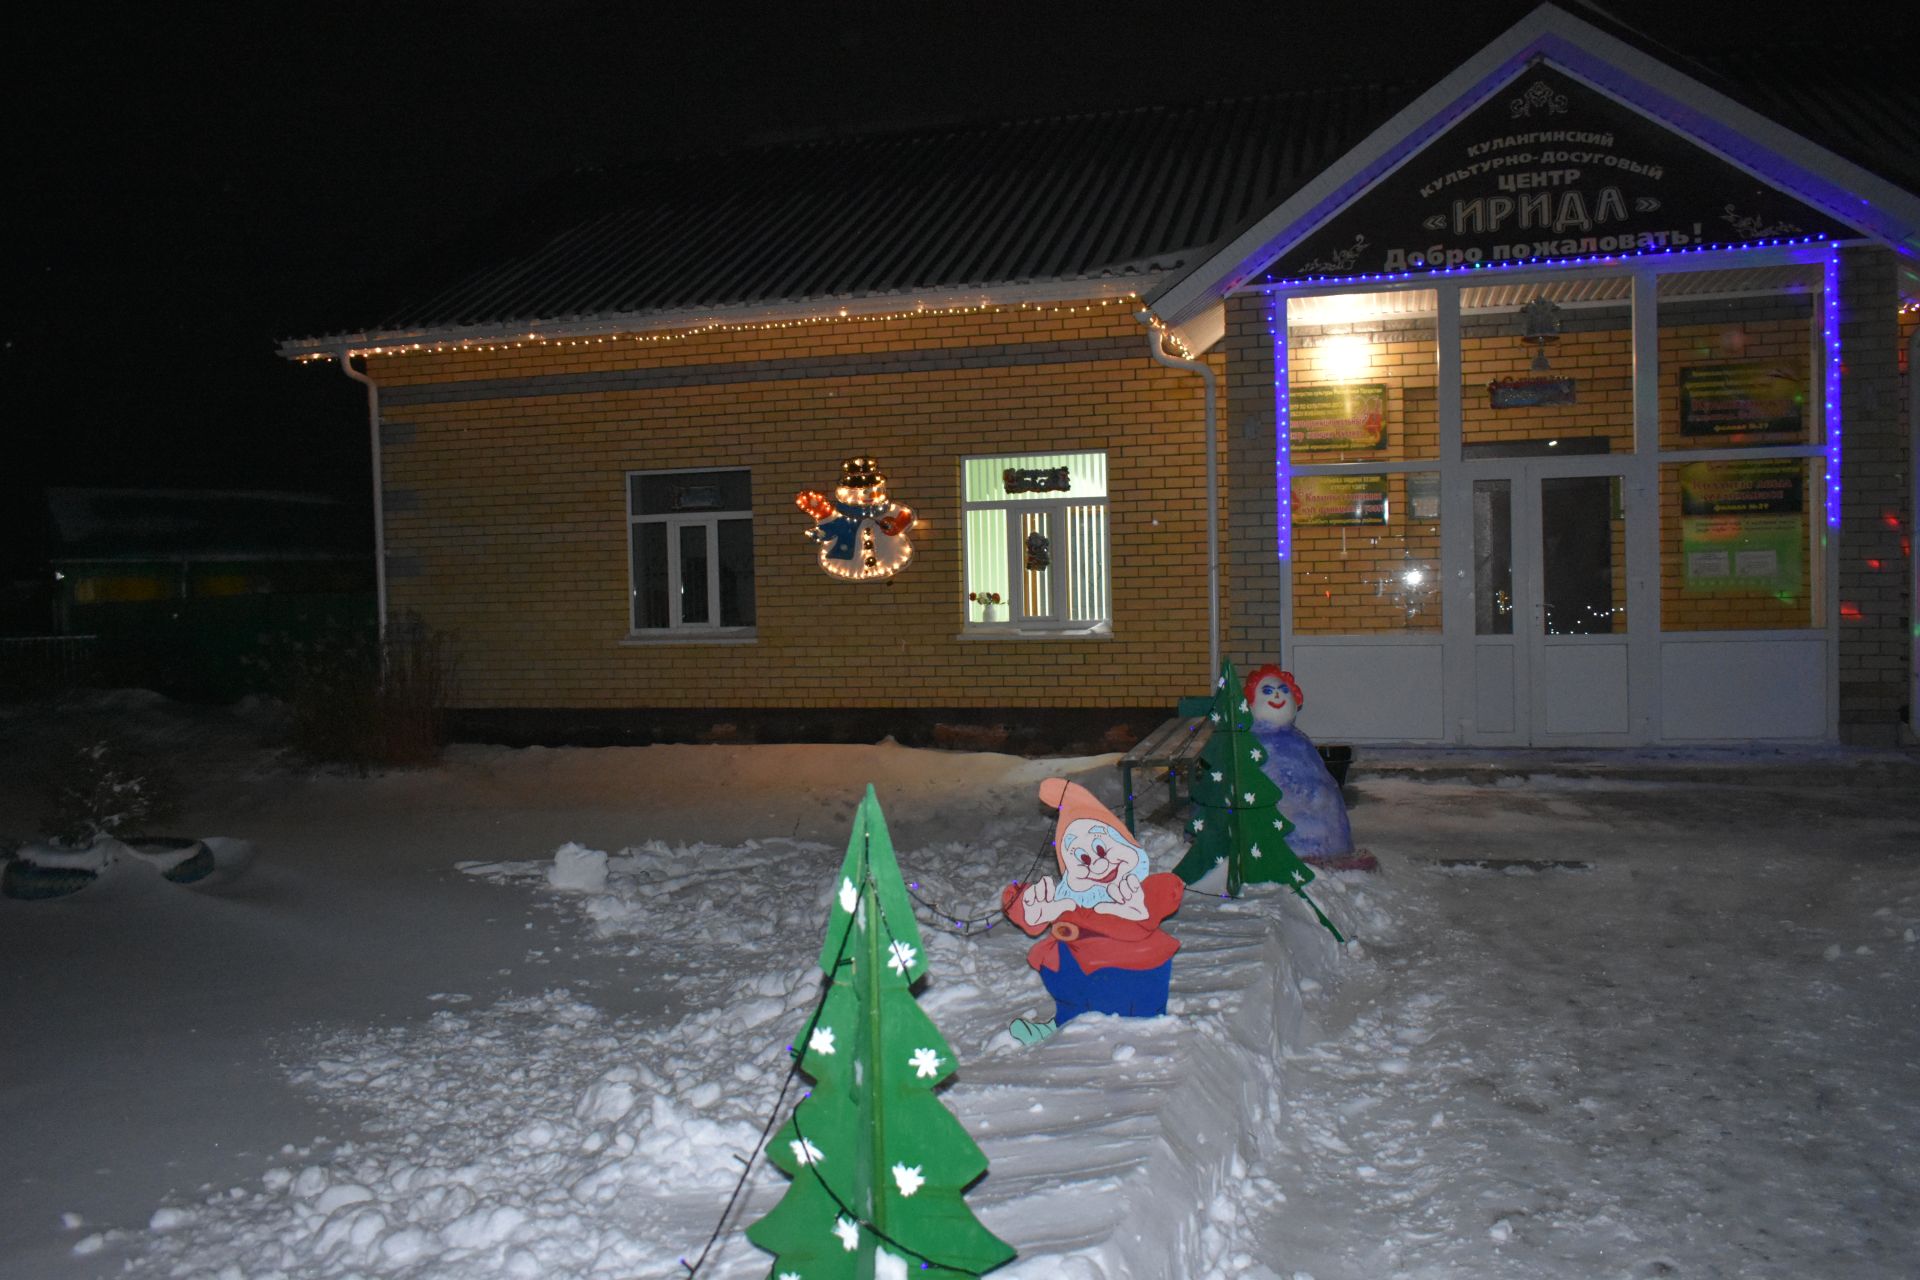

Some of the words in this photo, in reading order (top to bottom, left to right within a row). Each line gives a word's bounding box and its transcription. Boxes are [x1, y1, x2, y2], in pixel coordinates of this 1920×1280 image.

[1467, 131, 1615, 157] КУЛАНГИНСКИЙ
[1420, 151, 1665, 198] КУЛЬТУРНО-ДОСУГОВЫЙ
[1499, 169, 1581, 192] ЦЕНТР
[1384, 245, 1483, 272] Добро
[1493, 223, 1702, 259] пожаловать!
